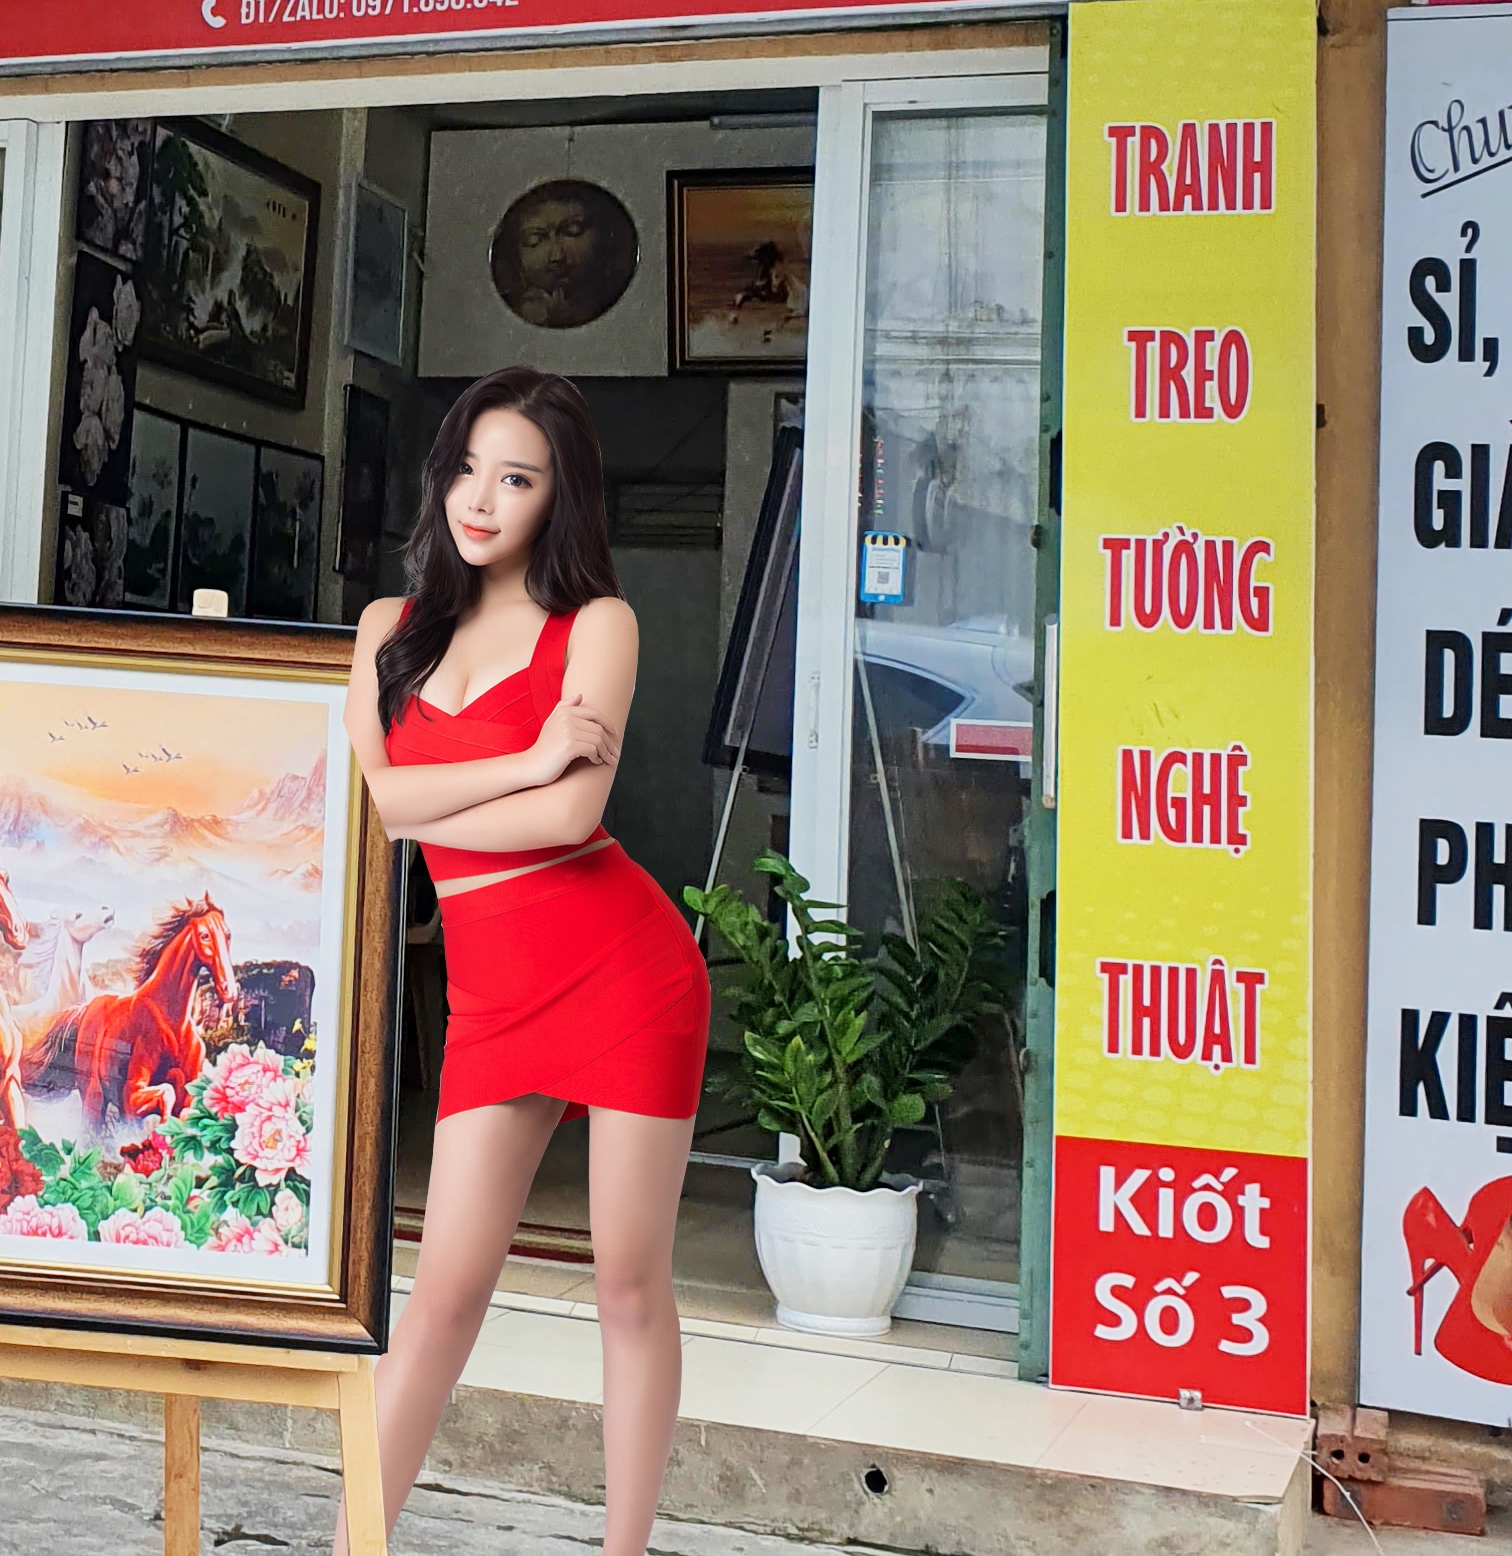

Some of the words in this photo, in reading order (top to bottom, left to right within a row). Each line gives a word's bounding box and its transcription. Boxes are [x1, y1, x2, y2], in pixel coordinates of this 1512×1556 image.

[1107, 121, 1273, 213] TRANH
[1410, 100, 1512, 184] Chu
[1407, 220, 1499, 377] SỈ,
[1126, 328, 1249, 420] TREO
[1102, 525, 1272, 632] TƯỜNG
[1120, 744, 1249, 855] NGHỆ
[1100, 959, 1266, 1071] THUẬT
[1098, 1165, 1270, 1246] Kiốt
[1094, 1271, 1201, 1347] Số
[1218, 1285, 1270, 1357] 3
